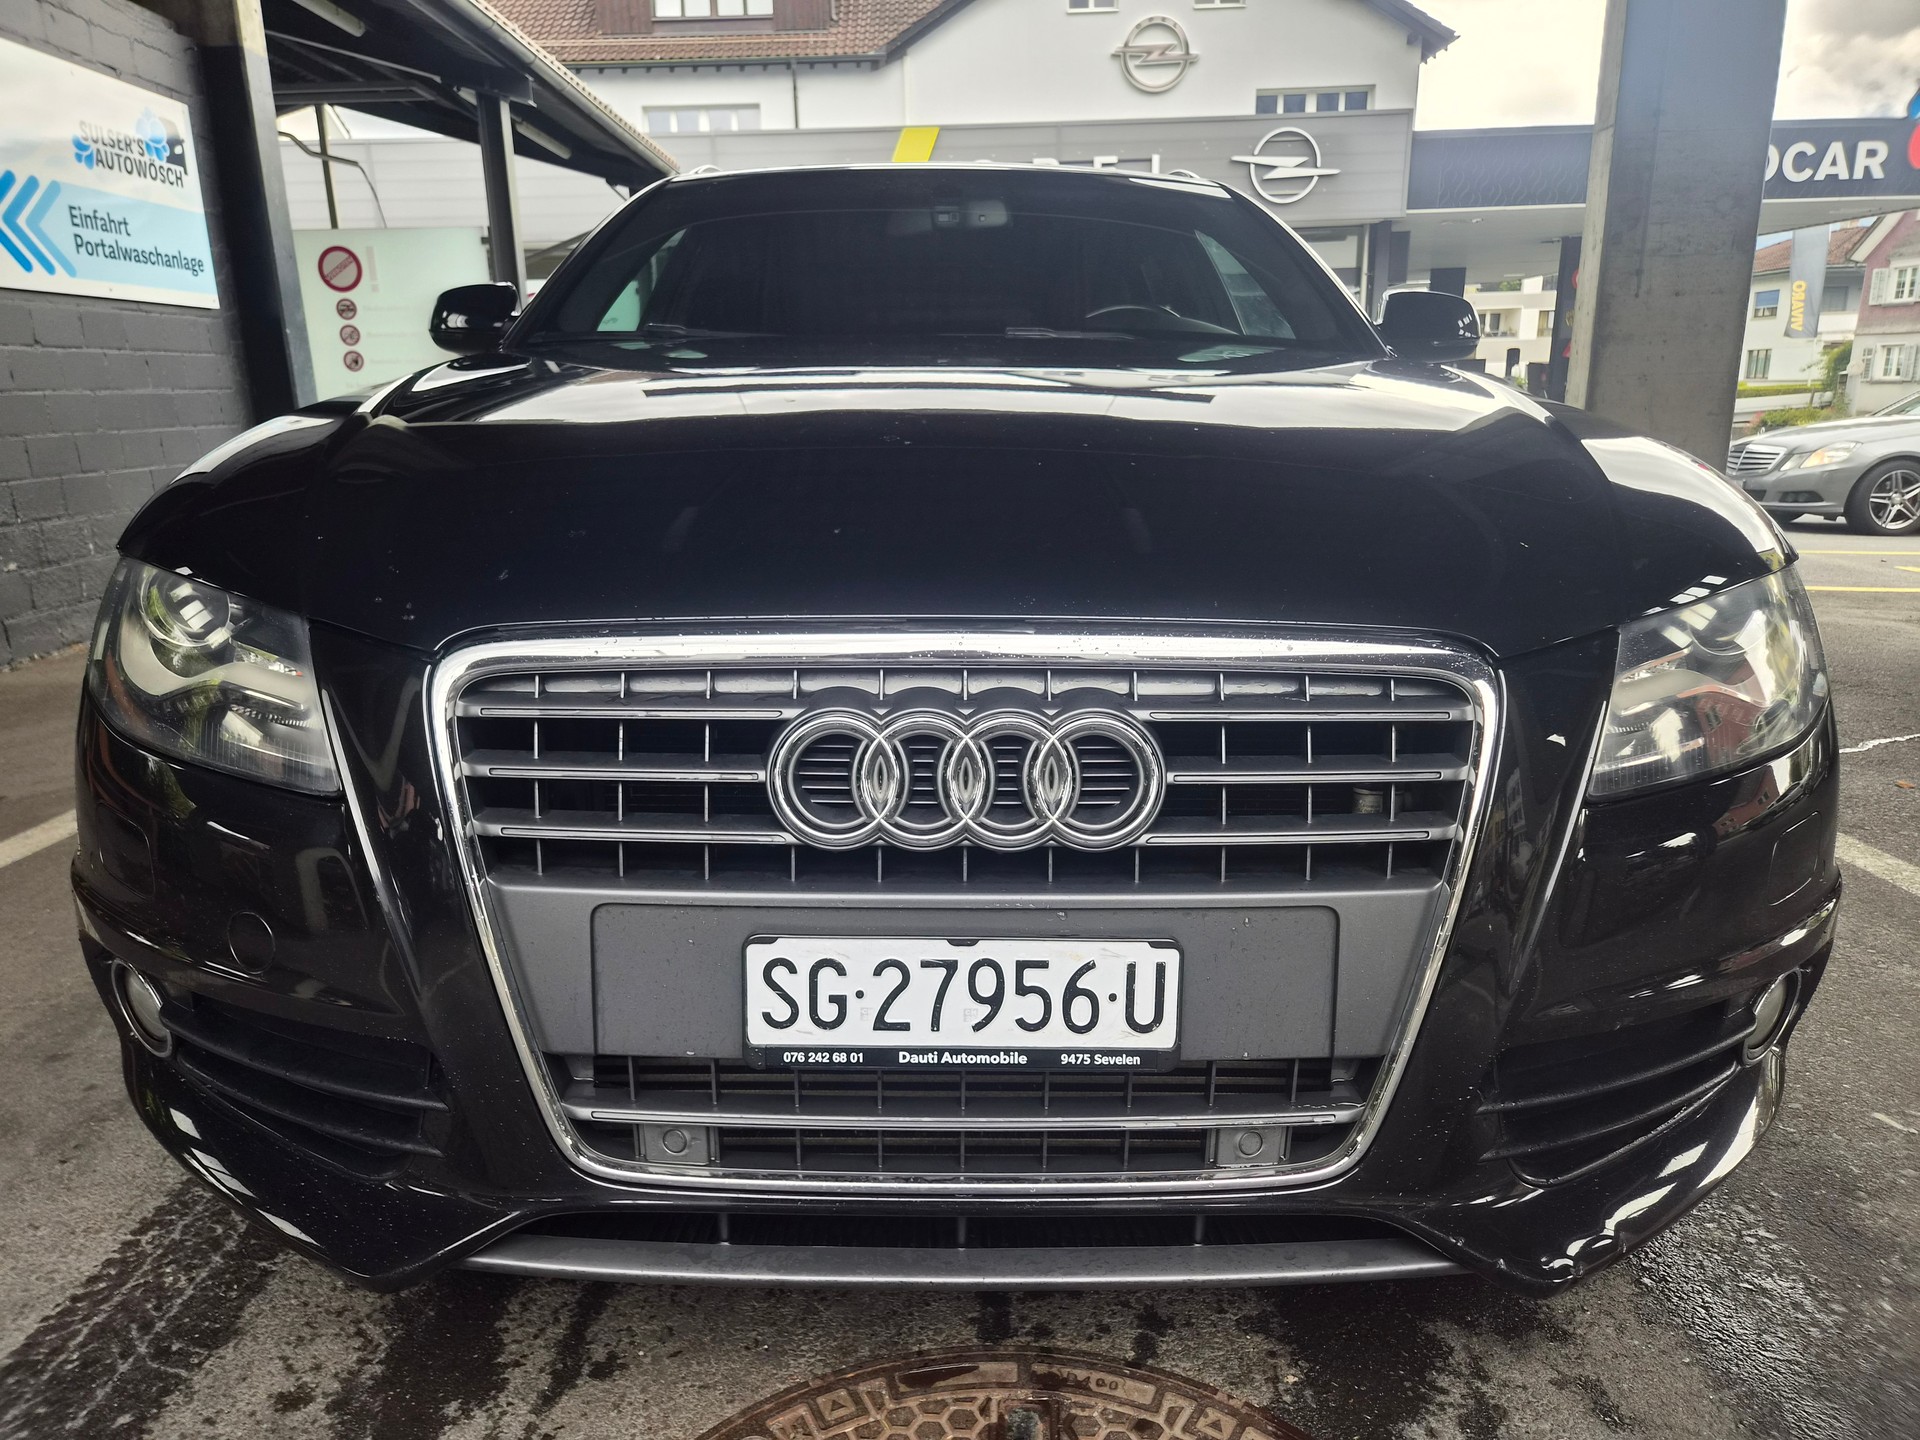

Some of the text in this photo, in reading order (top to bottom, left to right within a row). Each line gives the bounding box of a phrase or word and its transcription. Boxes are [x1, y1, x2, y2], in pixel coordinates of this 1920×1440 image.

[78, 120, 145, 157] SULSER'S
[95, 148, 184, 188] AUTOWÖSCH
[68, 204, 131, 236] Einfahrt
[73, 233, 204, 277] Portalwaschanlage
[783, 1051, 1141, 1066] 076 242 68 01 Dauti Automobile 9475 Sevelen
